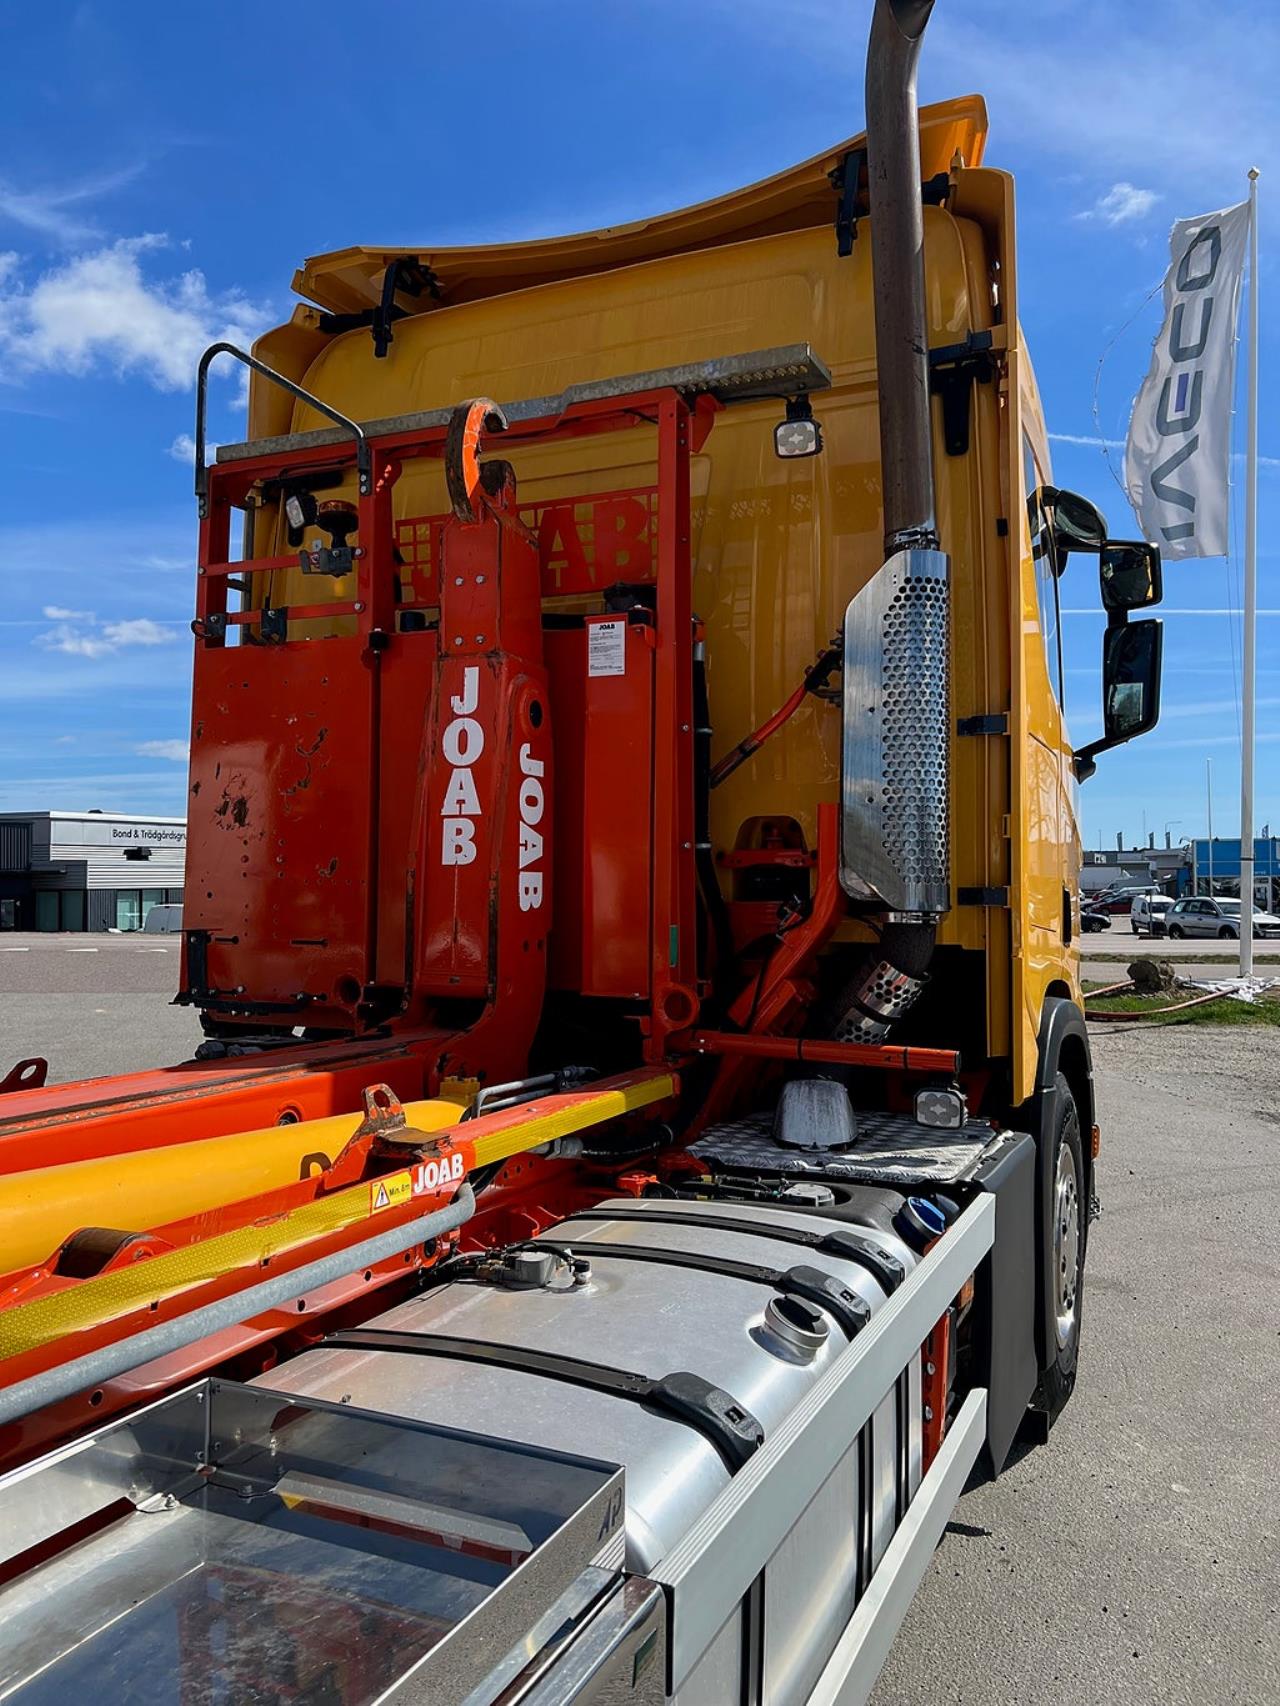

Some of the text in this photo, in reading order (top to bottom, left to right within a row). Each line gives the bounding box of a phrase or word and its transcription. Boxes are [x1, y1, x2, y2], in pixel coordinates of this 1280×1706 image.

[599, 623, 616, 631] JOAB
[440, 666, 485, 866] JOAB
[133, 829, 139, 839] &
[519, 743, 545, 912] JOAB
[414, 1153, 464, 1193] JOAB
